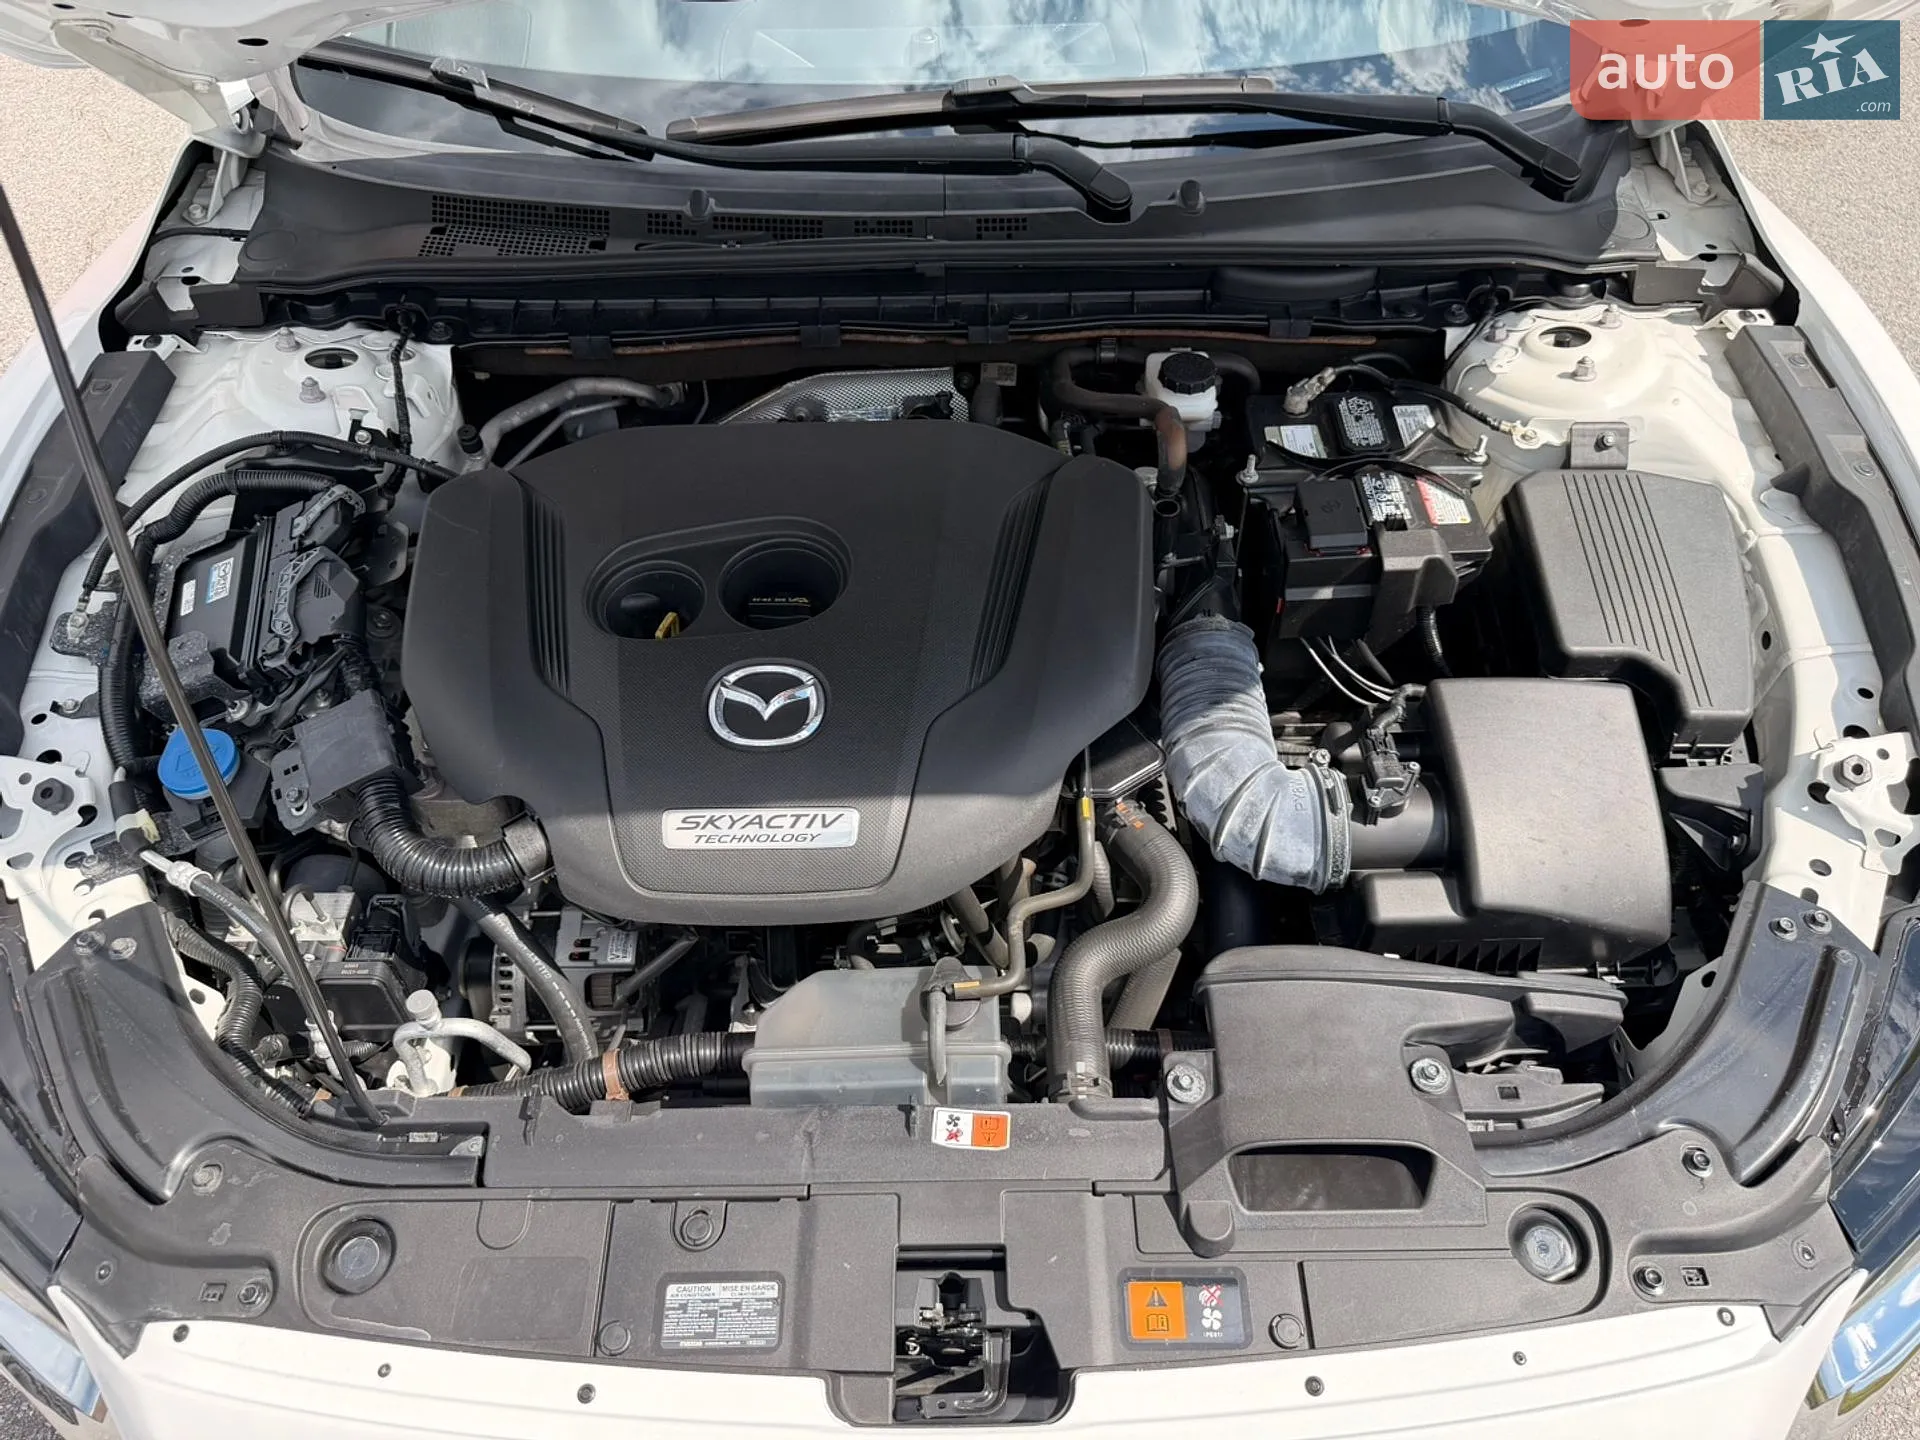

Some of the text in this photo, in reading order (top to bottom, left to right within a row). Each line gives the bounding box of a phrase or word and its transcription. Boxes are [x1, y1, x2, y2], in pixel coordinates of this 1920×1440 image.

[675, 813, 845, 831] SKYACTIV
[694, 833, 821, 844] TECHNOLOGY
[675, 1285, 712, 1293] CAUTION
[722, 1284, 739, 1292] MISE
